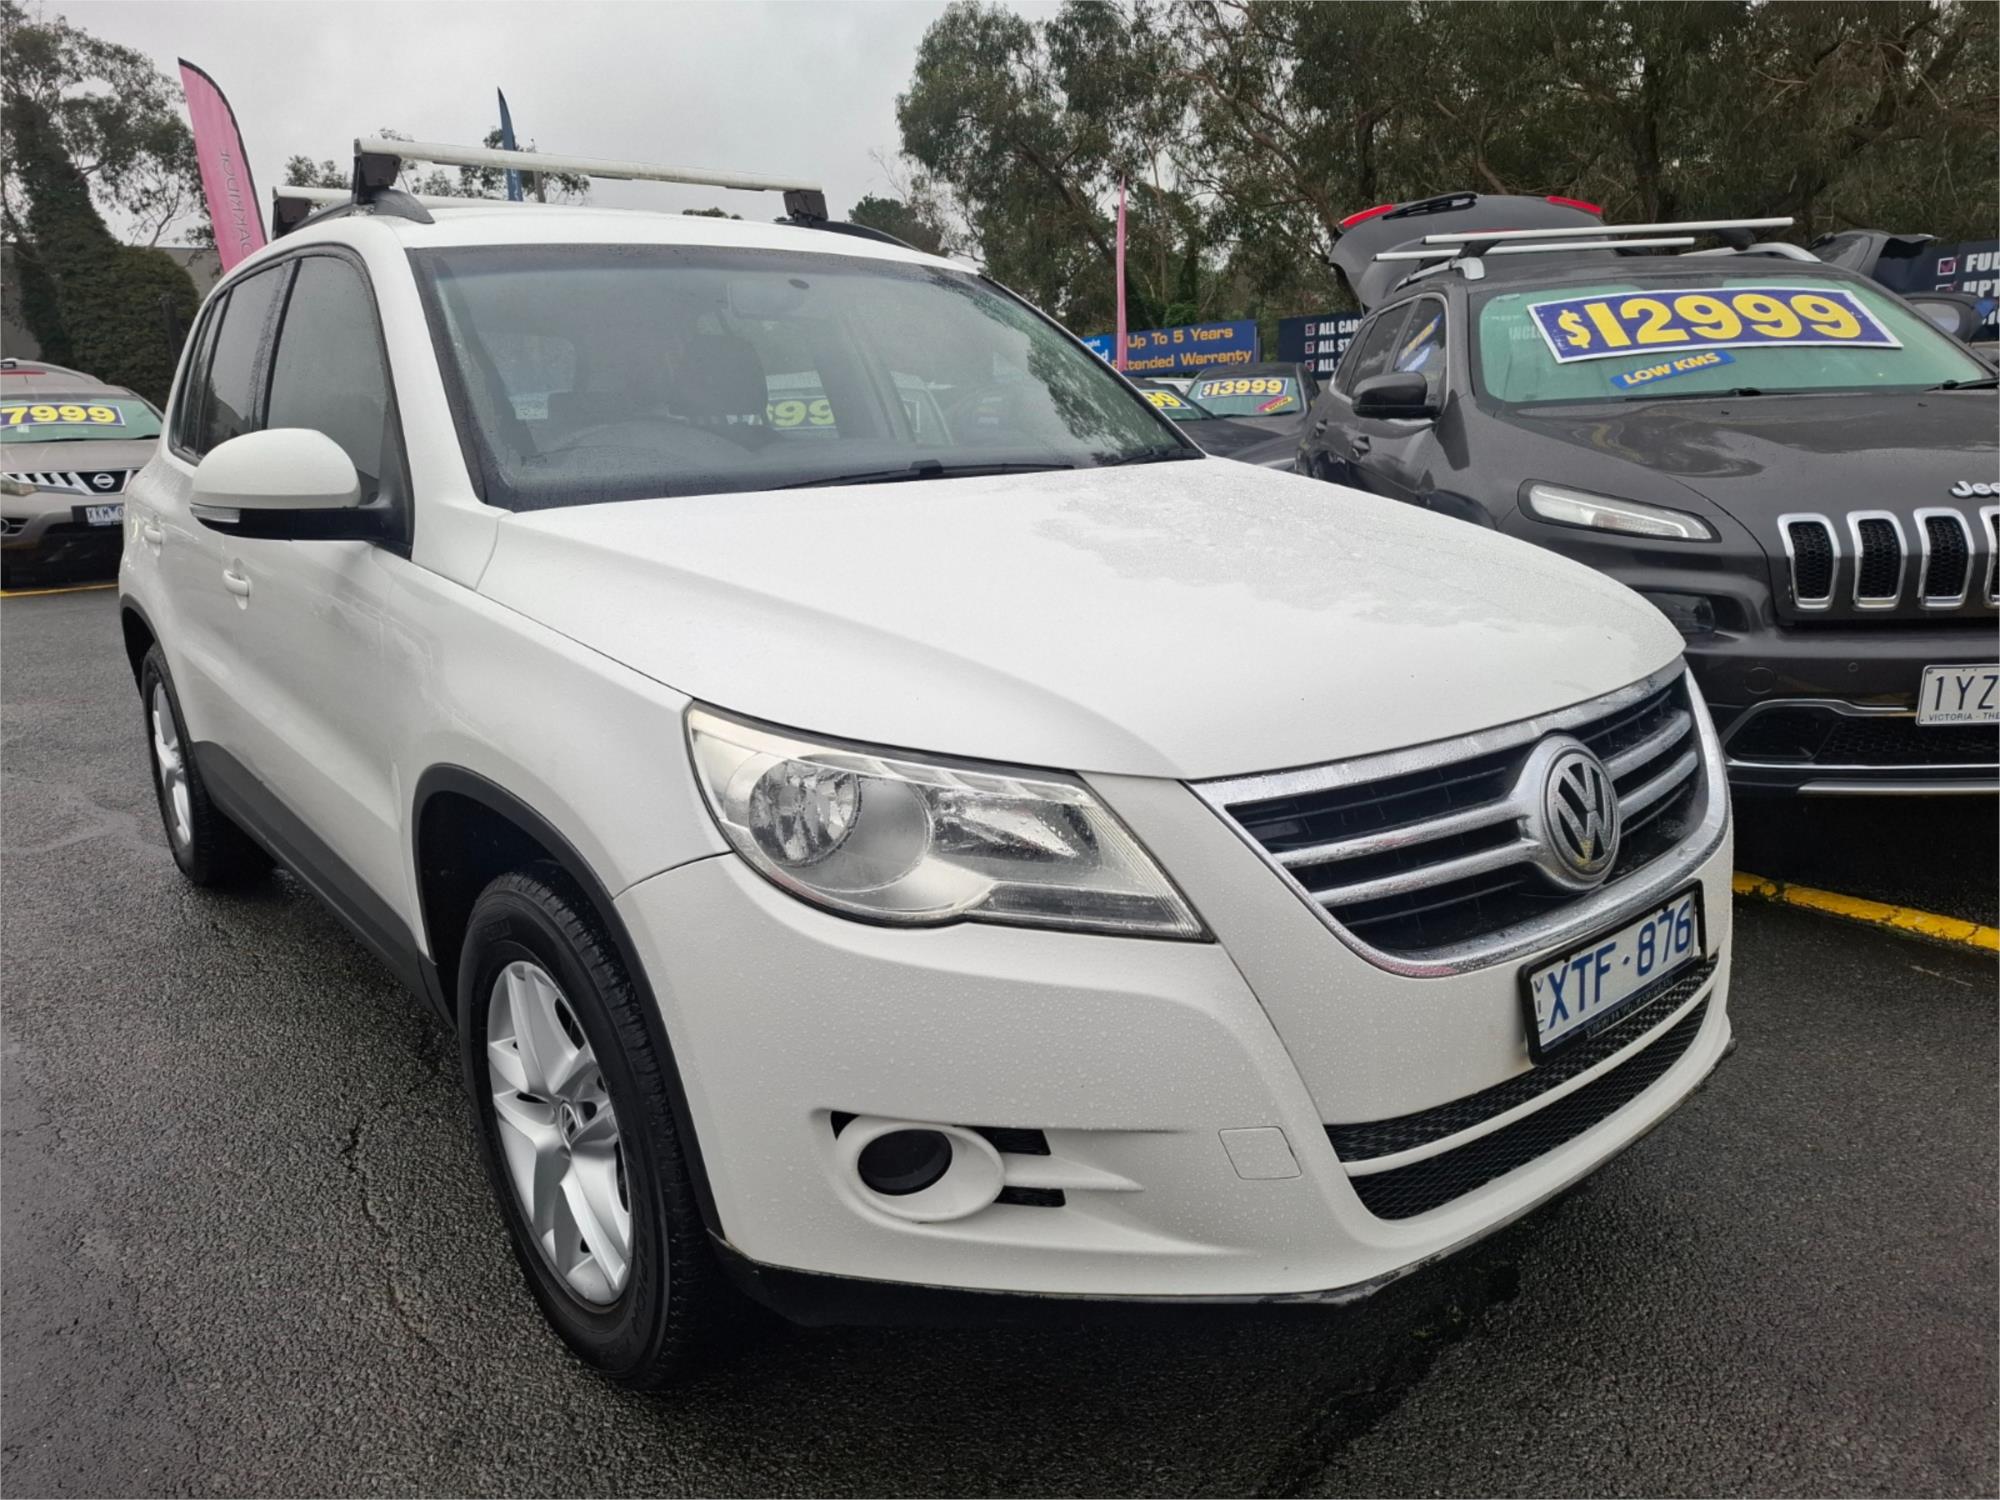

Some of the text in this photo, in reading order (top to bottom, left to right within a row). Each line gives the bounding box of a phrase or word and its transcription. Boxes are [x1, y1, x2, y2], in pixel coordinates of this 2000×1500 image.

[1319, 318, 1363, 335] ALL CAR
[1557, 293, 1862, 349] $12999
[1126, 327, 1234, 349] Up To 5 Years
[1318, 340, 1335, 353] ALL
[1112, 354, 1175, 371] Etended
[1180, 349, 1252, 367] Warranty
[1318, 358, 1335, 372] ALL
[1623, 352, 1720, 385] LOW KMS
[1202, 379, 1283, 396] $13999
[0, 405, 117, 425] 7999
[1934, 675, 1999, 711] 1YZ
[1928, 713, 1973, 721] VICTORIA
